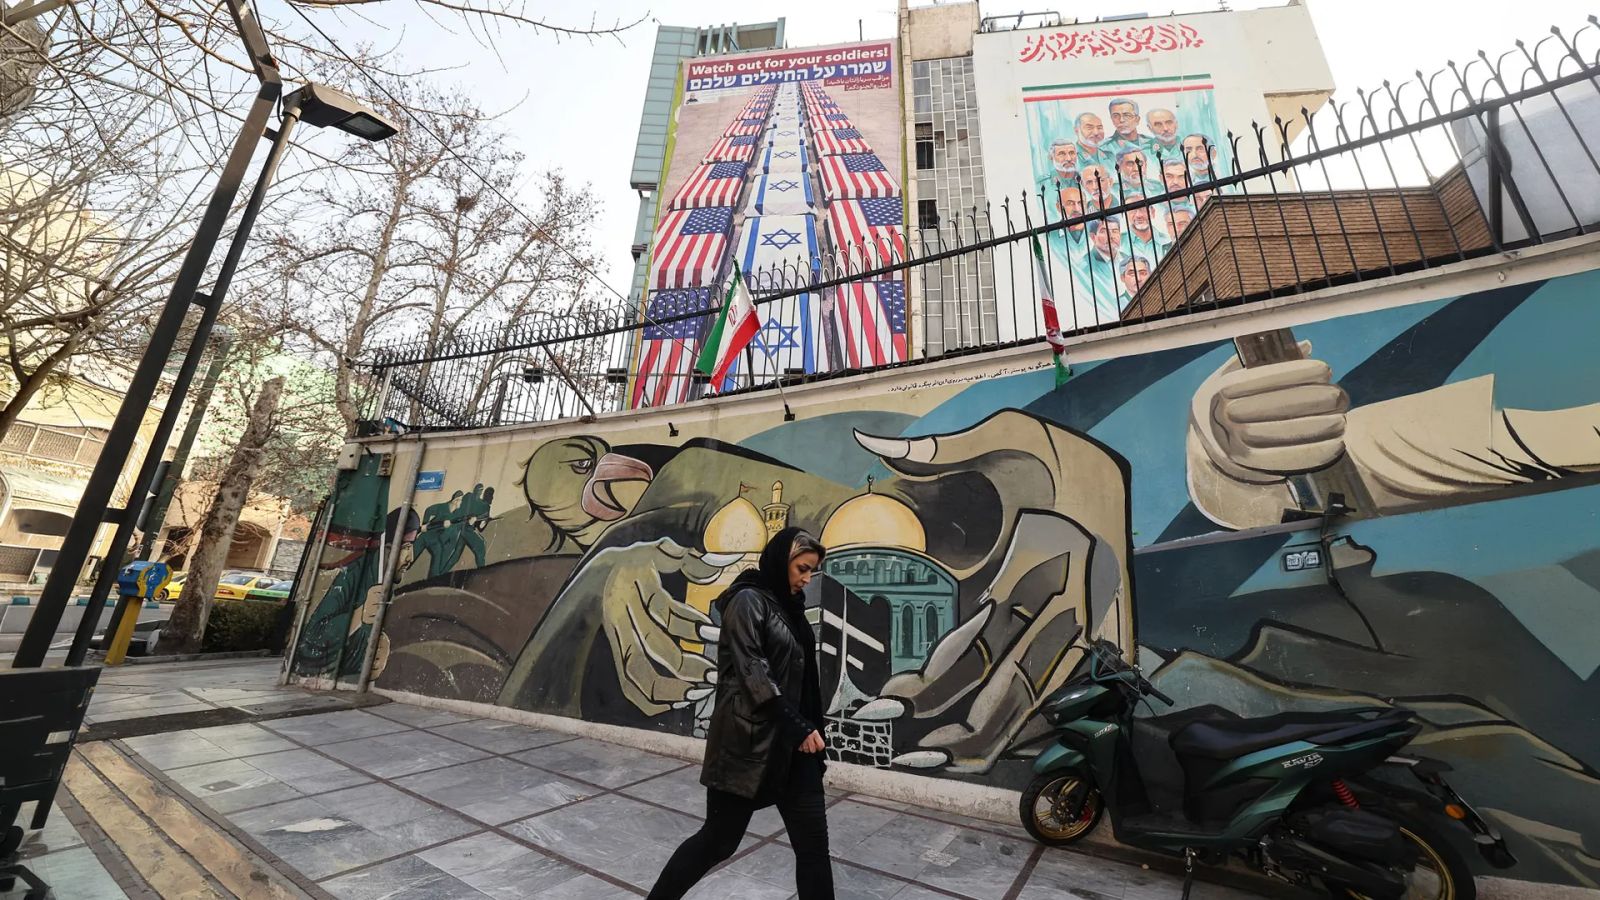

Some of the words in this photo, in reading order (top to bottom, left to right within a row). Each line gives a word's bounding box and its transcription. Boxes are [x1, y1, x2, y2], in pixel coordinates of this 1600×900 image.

[691, 61, 734, 76] Watch
[737, 60, 762, 71] out
[765, 57, 786, 68] for
[789, 55, 821, 68] your
[825, 46, 889, 62] soldiers!
[840, 60, 887, 76] שמרו
[741, 68, 809, 87] החיילים
[813, 64, 836, 80] על
[689, 74, 737, 91] שלכם
